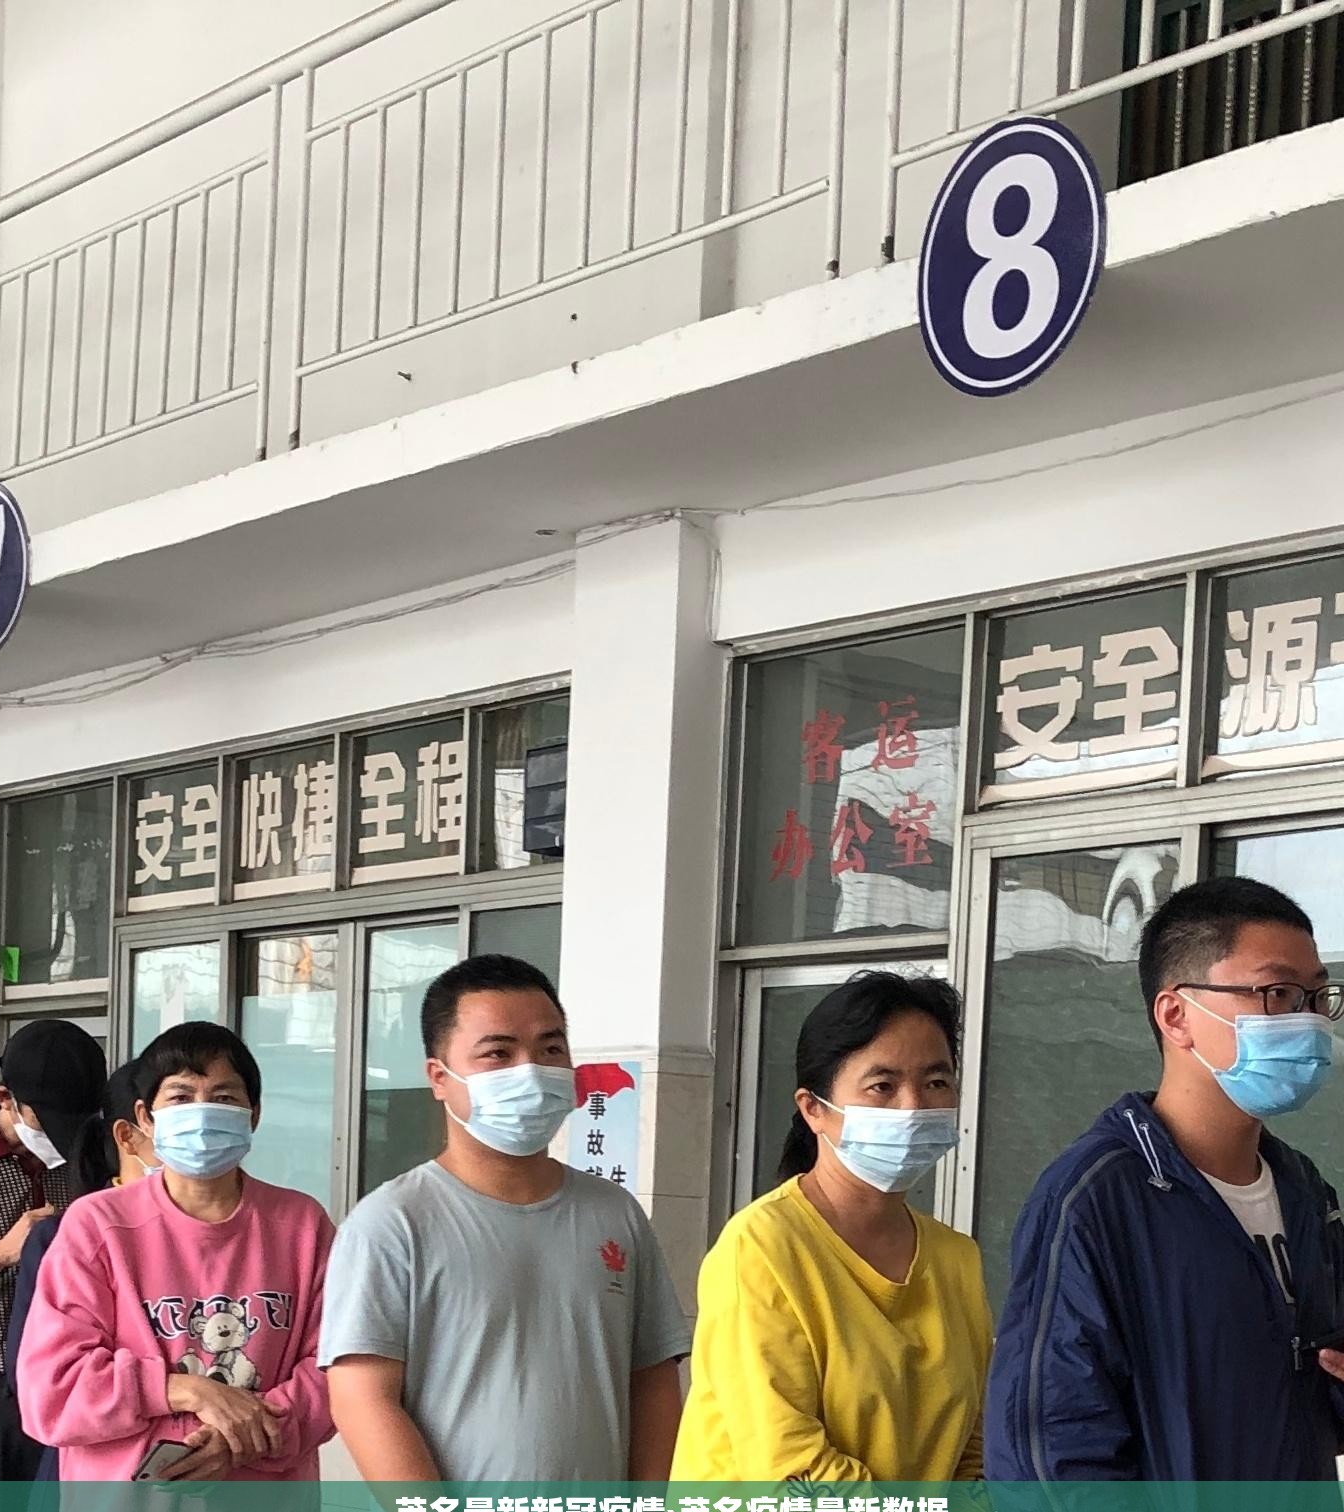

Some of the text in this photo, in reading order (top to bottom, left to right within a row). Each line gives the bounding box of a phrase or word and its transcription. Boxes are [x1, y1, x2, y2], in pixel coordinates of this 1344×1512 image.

[962, 153, 1060, 359] 8
[800, 694, 920, 783] 客运
[768, 790, 937, 882] 办公室
